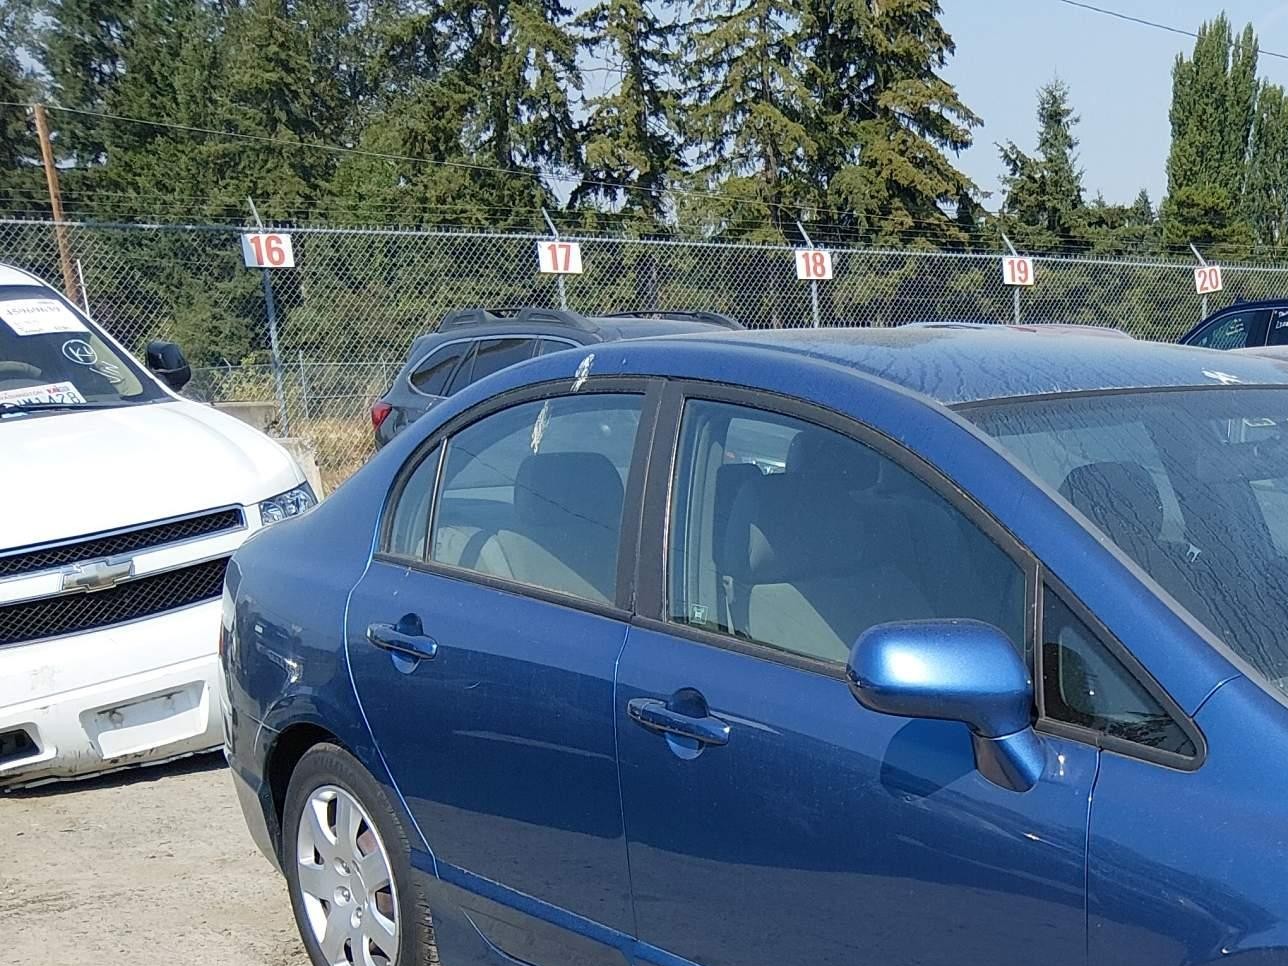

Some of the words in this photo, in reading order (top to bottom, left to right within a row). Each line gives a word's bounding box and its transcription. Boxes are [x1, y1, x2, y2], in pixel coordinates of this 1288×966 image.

[250, 235, 285, 265] 16
[548, 244, 571, 271] 17
[802, 252, 825, 277] 18
[1008, 259, 1028, 283] 19
[1198, 268, 1218, 291] 20
